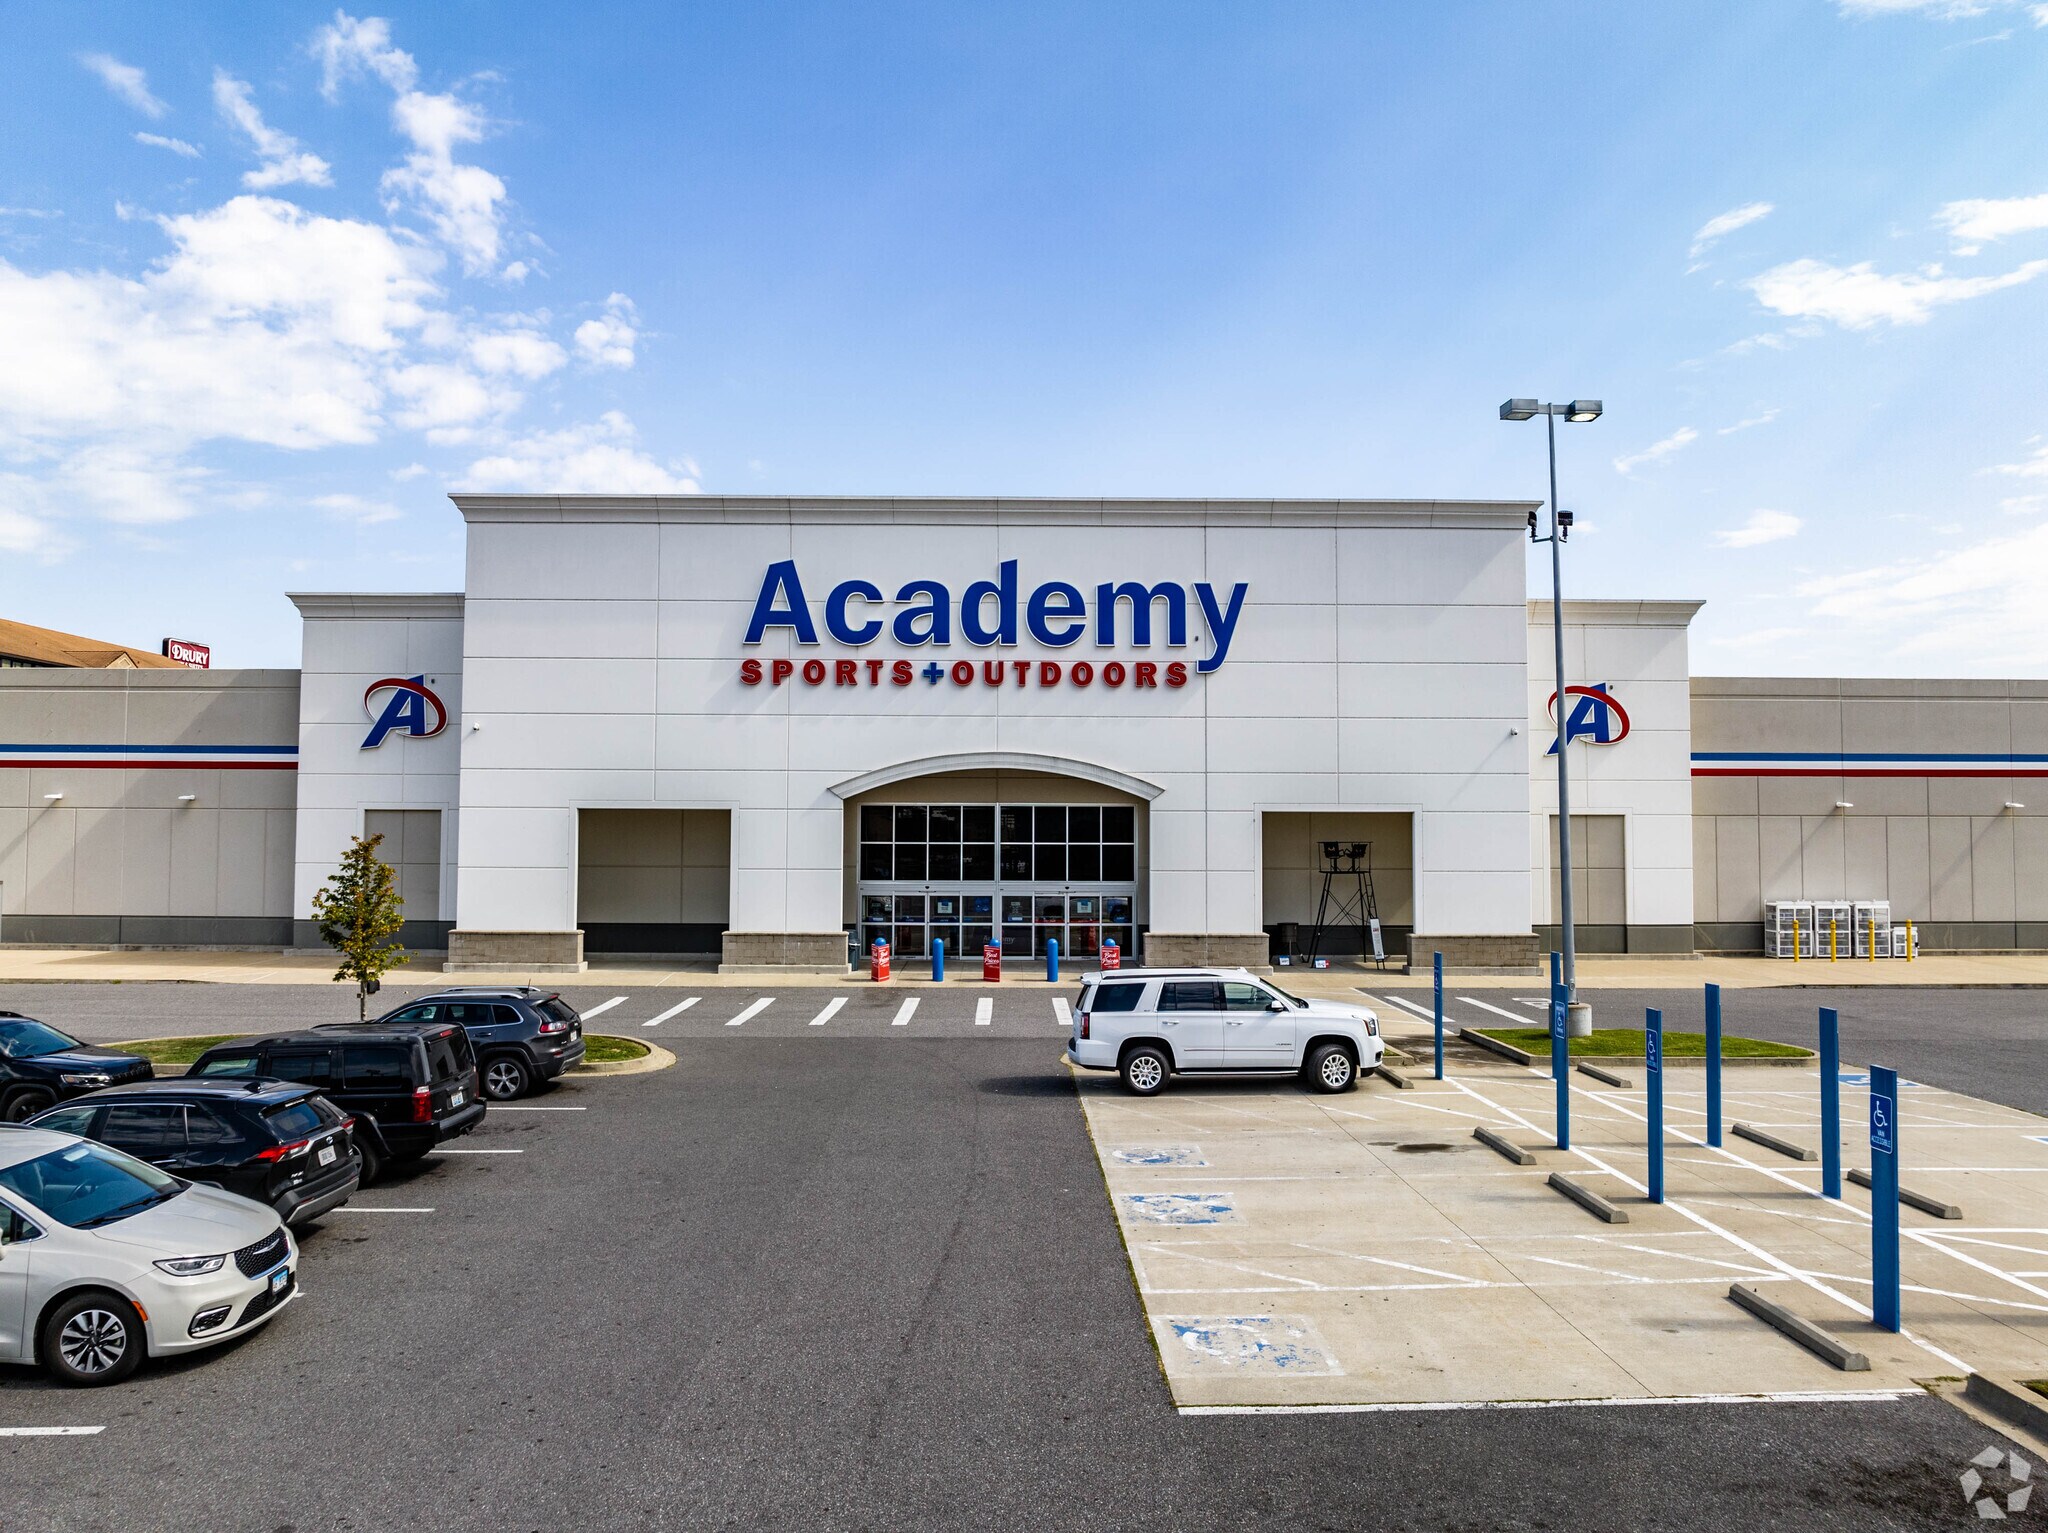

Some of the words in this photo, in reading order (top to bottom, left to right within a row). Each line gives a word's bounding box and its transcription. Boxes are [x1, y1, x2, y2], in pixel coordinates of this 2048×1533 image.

[171, 644, 208, 664] DRURY
[743, 558, 1248, 673] Academy
[360, 673, 426, 750] A
